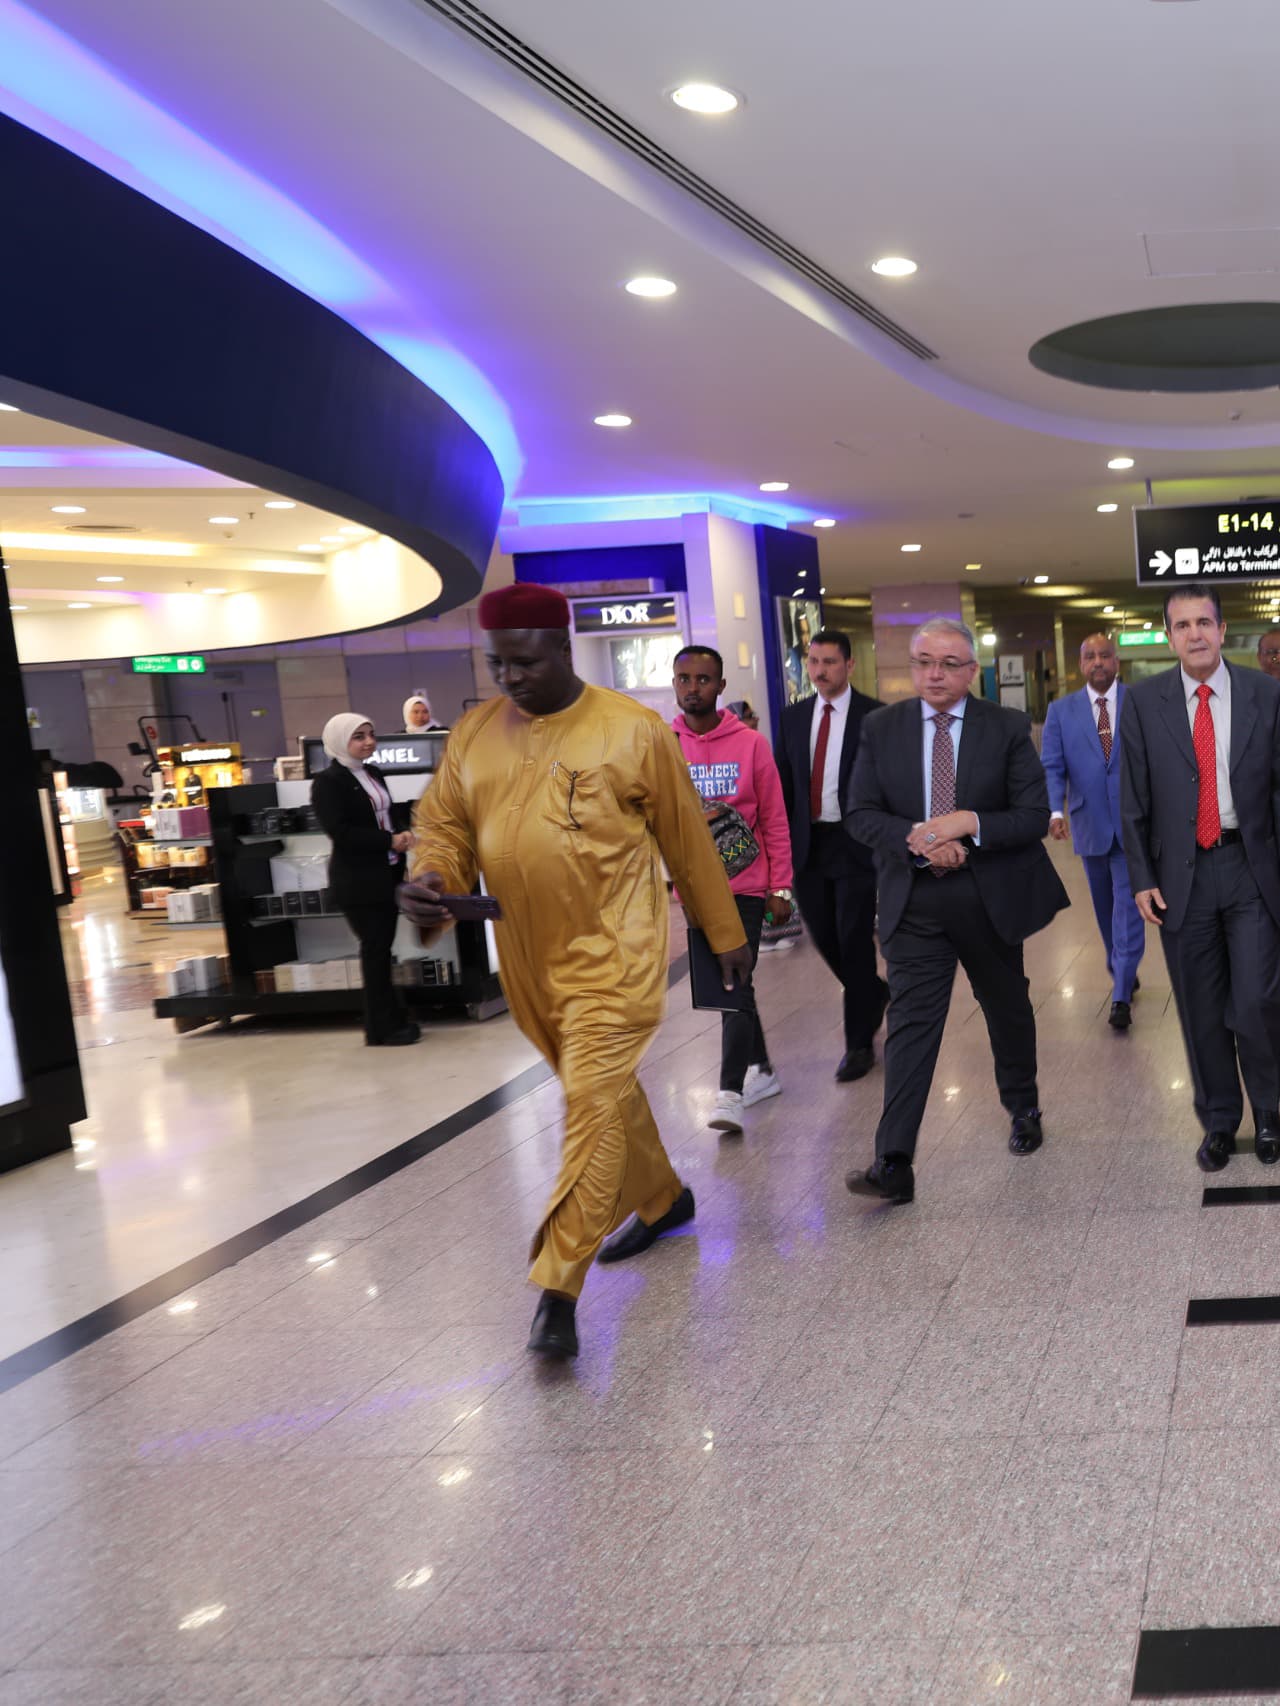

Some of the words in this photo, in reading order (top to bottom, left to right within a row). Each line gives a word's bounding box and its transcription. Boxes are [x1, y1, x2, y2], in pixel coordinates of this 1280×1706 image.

[1202, 561, 1225, 574] APM
[1227, 561, 1239, 572] to
[1240, 558, 1280, 572] Terminal
[600, 602, 650, 625] DIOR
[363, 747, 420, 764] ANEL
[690, 764, 738, 780] EDNECK
[693, 779, 738, 796] RRRL
